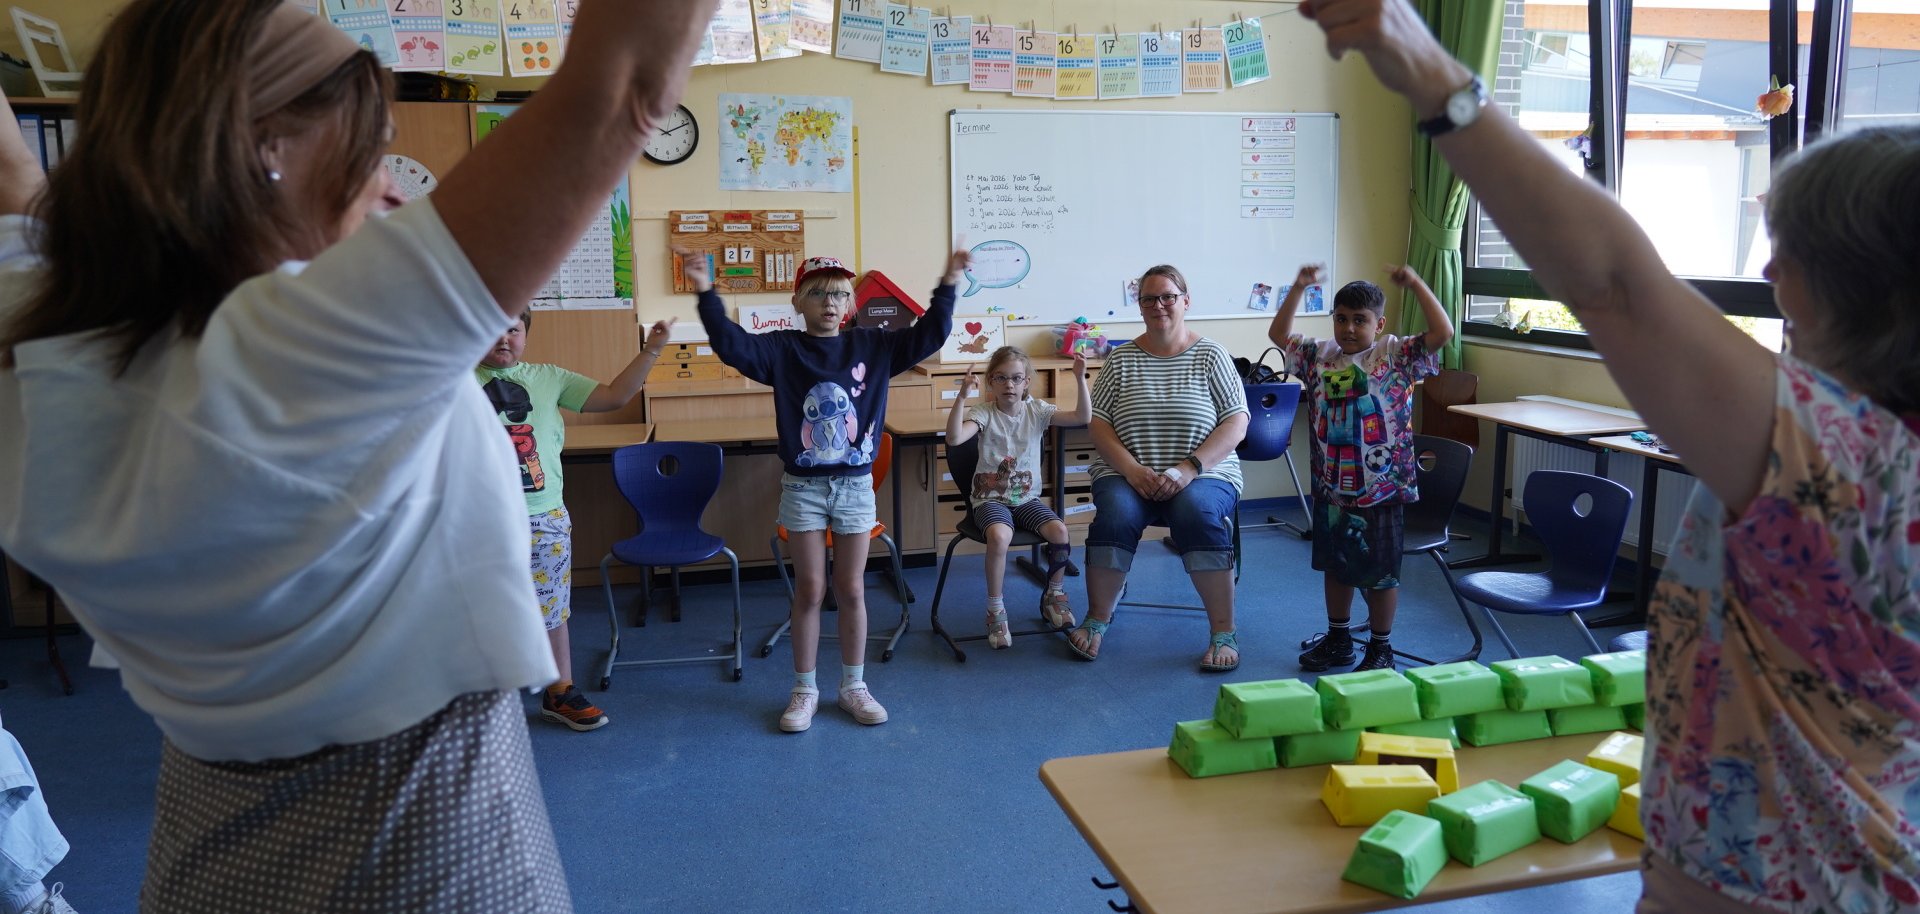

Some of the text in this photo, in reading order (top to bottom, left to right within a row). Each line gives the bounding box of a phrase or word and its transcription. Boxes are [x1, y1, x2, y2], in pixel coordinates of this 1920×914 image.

[452, 0, 463, 16] 3
[510, 3, 522, 20] 4
[567, 1, 576, 18] 5
[850, 0, 860, 12] 11
[890, 11, 905, 26] 12
[933, 23, 949, 38] 13
[975, 30, 990, 45] 14
[1227, 28, 1244, 44] 20
[1018, 36, 1033, 51] 15
[1058, 40, 1073, 54] 16
[1102, 40, 1115, 54] 17
[1144, 38, 1158, 53] 18
[1188, 34, 1201, 48] 19
[956, 122, 990, 133] Termine
[1021, 206, 1054, 222] Ausflug
[1022, 220, 1040, 230] Ferien
[728, 250, 750, 260] 2 7
[730, 280, 753, 288] 2026
[752, 316, 794, 330] lumpi
